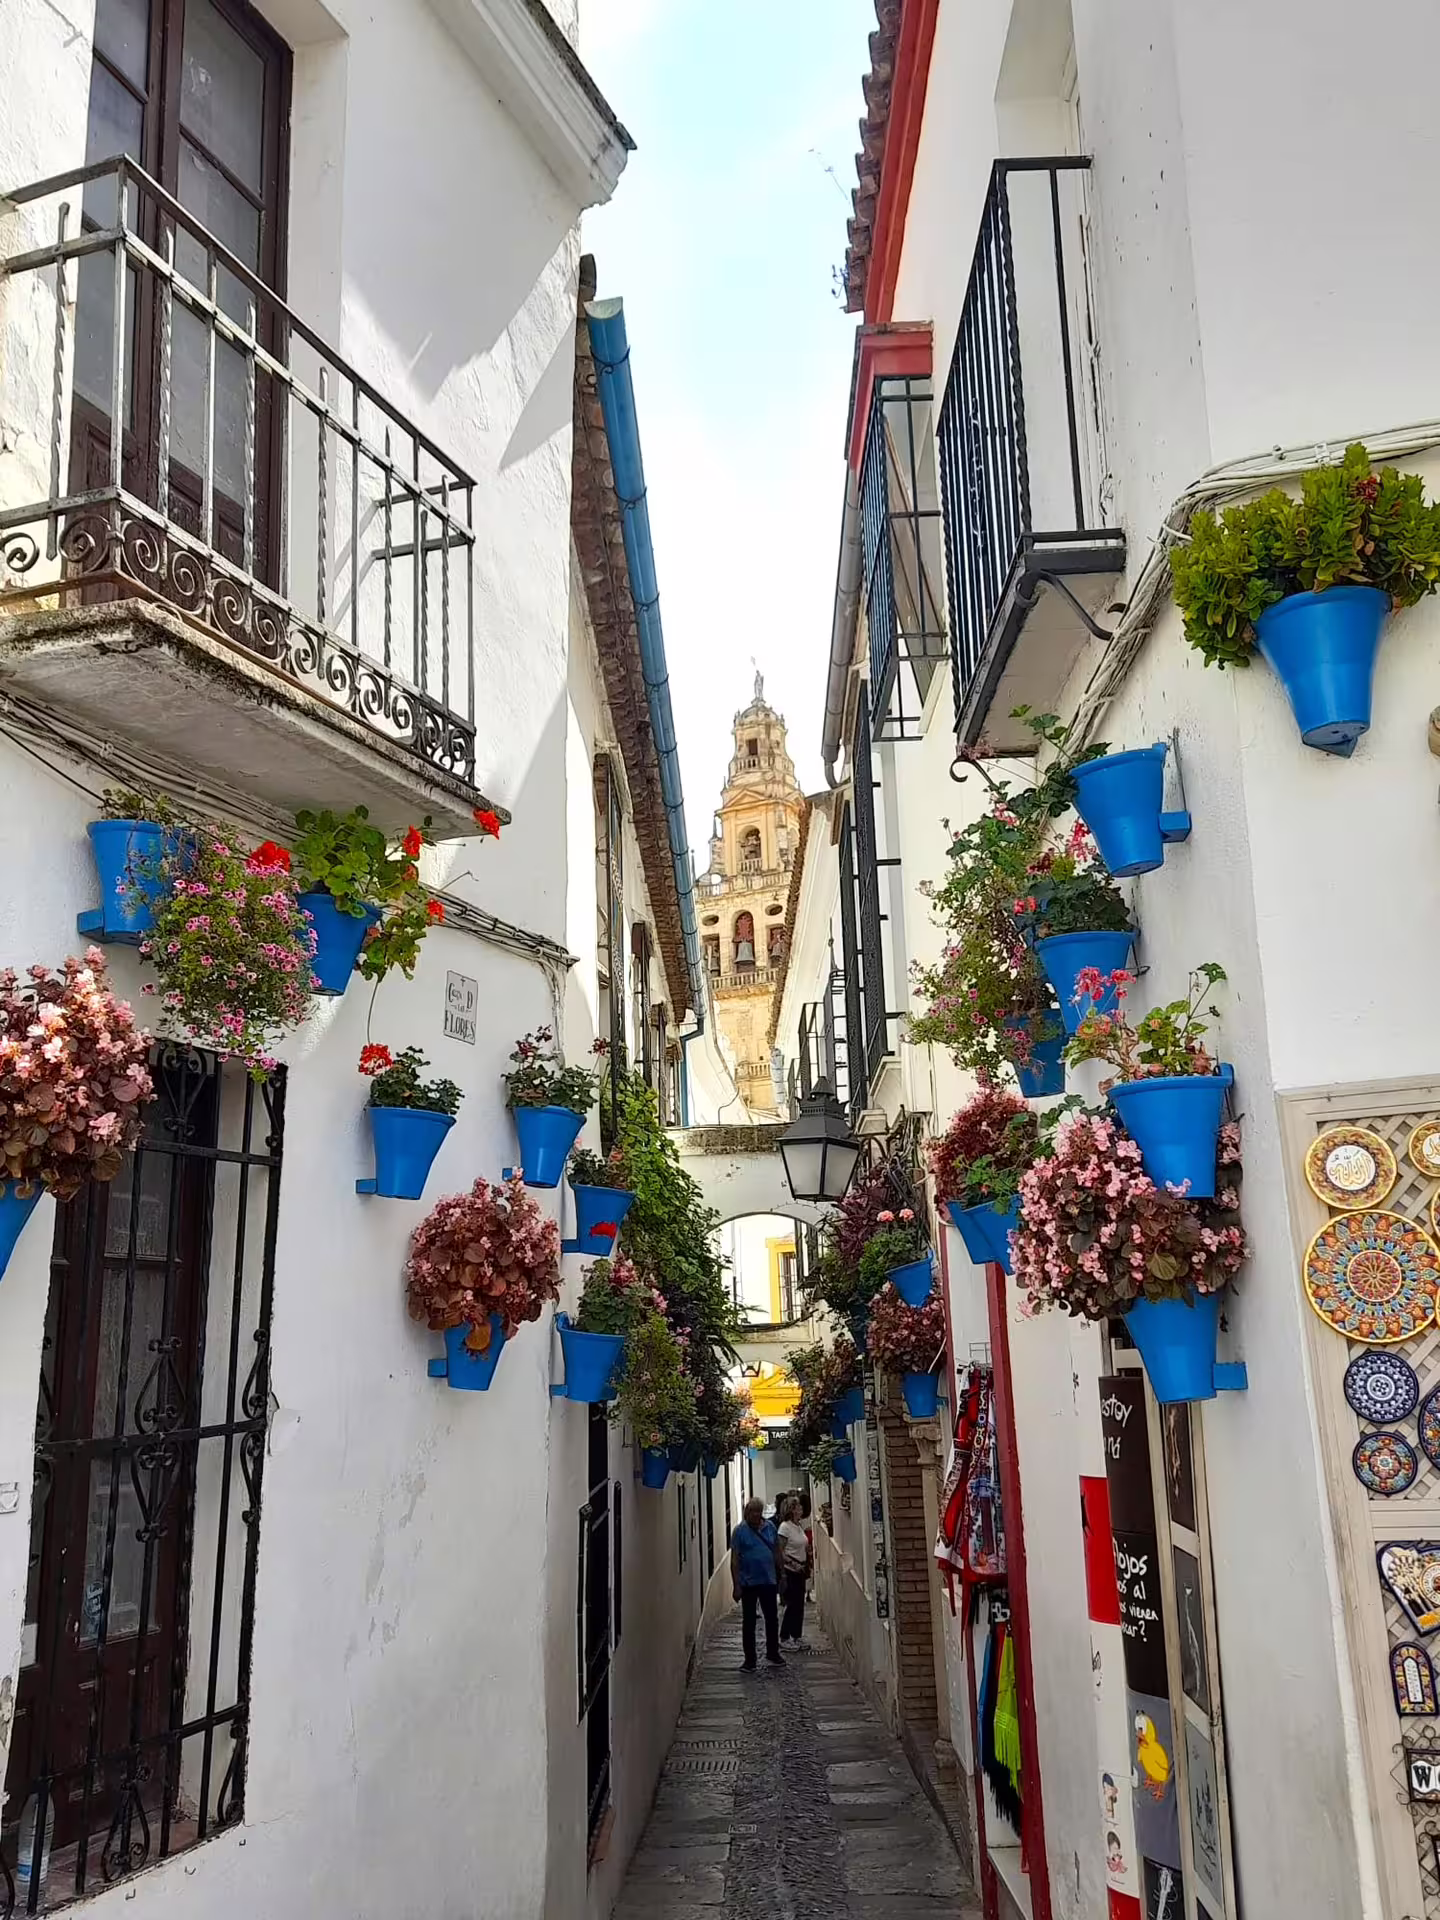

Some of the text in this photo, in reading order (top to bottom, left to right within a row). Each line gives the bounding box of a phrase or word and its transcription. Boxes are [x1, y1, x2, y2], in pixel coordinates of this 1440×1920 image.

[444, 1010, 476, 1040] FLORES
[1133, 1581, 1146, 1600] al
[1129, 1603, 1159, 1621] vienen
